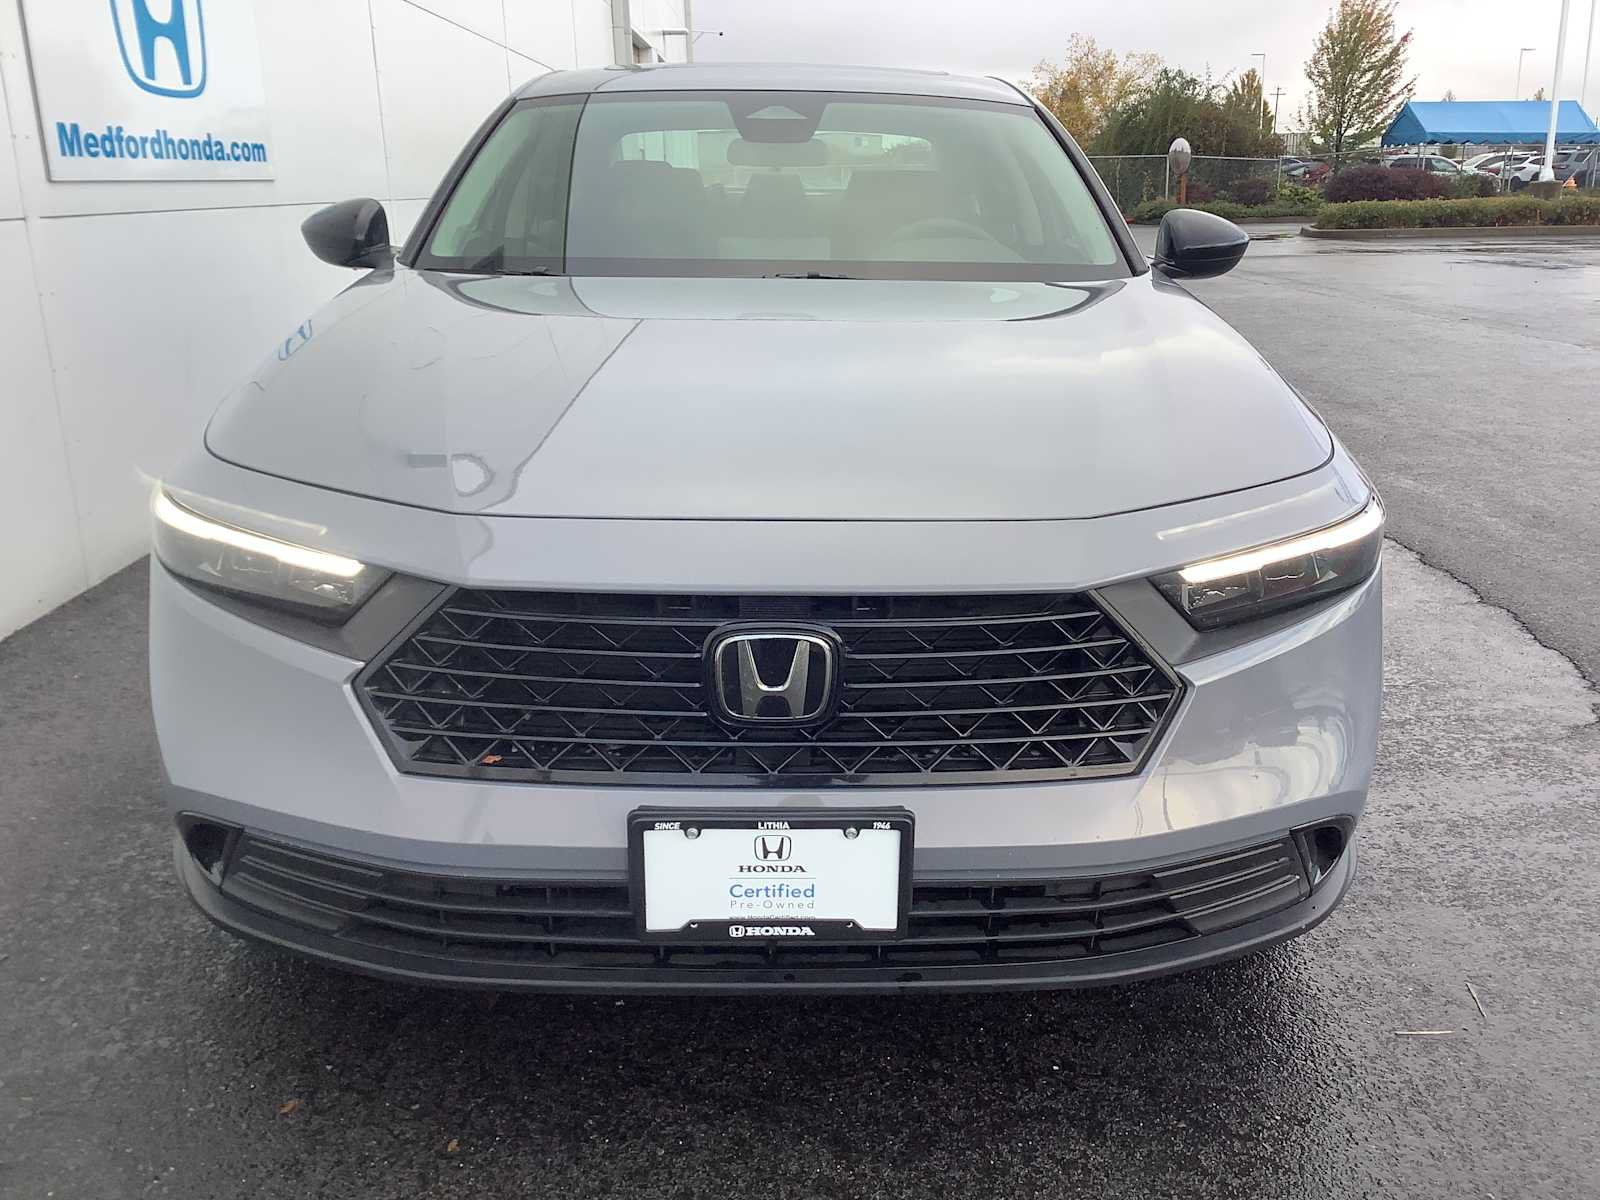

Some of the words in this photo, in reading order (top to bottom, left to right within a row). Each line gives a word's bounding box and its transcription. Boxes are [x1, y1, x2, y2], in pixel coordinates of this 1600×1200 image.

[56, 121, 267, 162] Medfordhonda.com
[654, 821, 681, 830] SINCE
[757, 821, 791, 830] LITHIA
[872, 821, 891, 830] 1946
[738, 864, 807, 873] HONDA
[729, 883, 815, 898] Certified
[730, 900, 815, 909] Pre-Owned
[745, 926, 816, 936] HONDA
